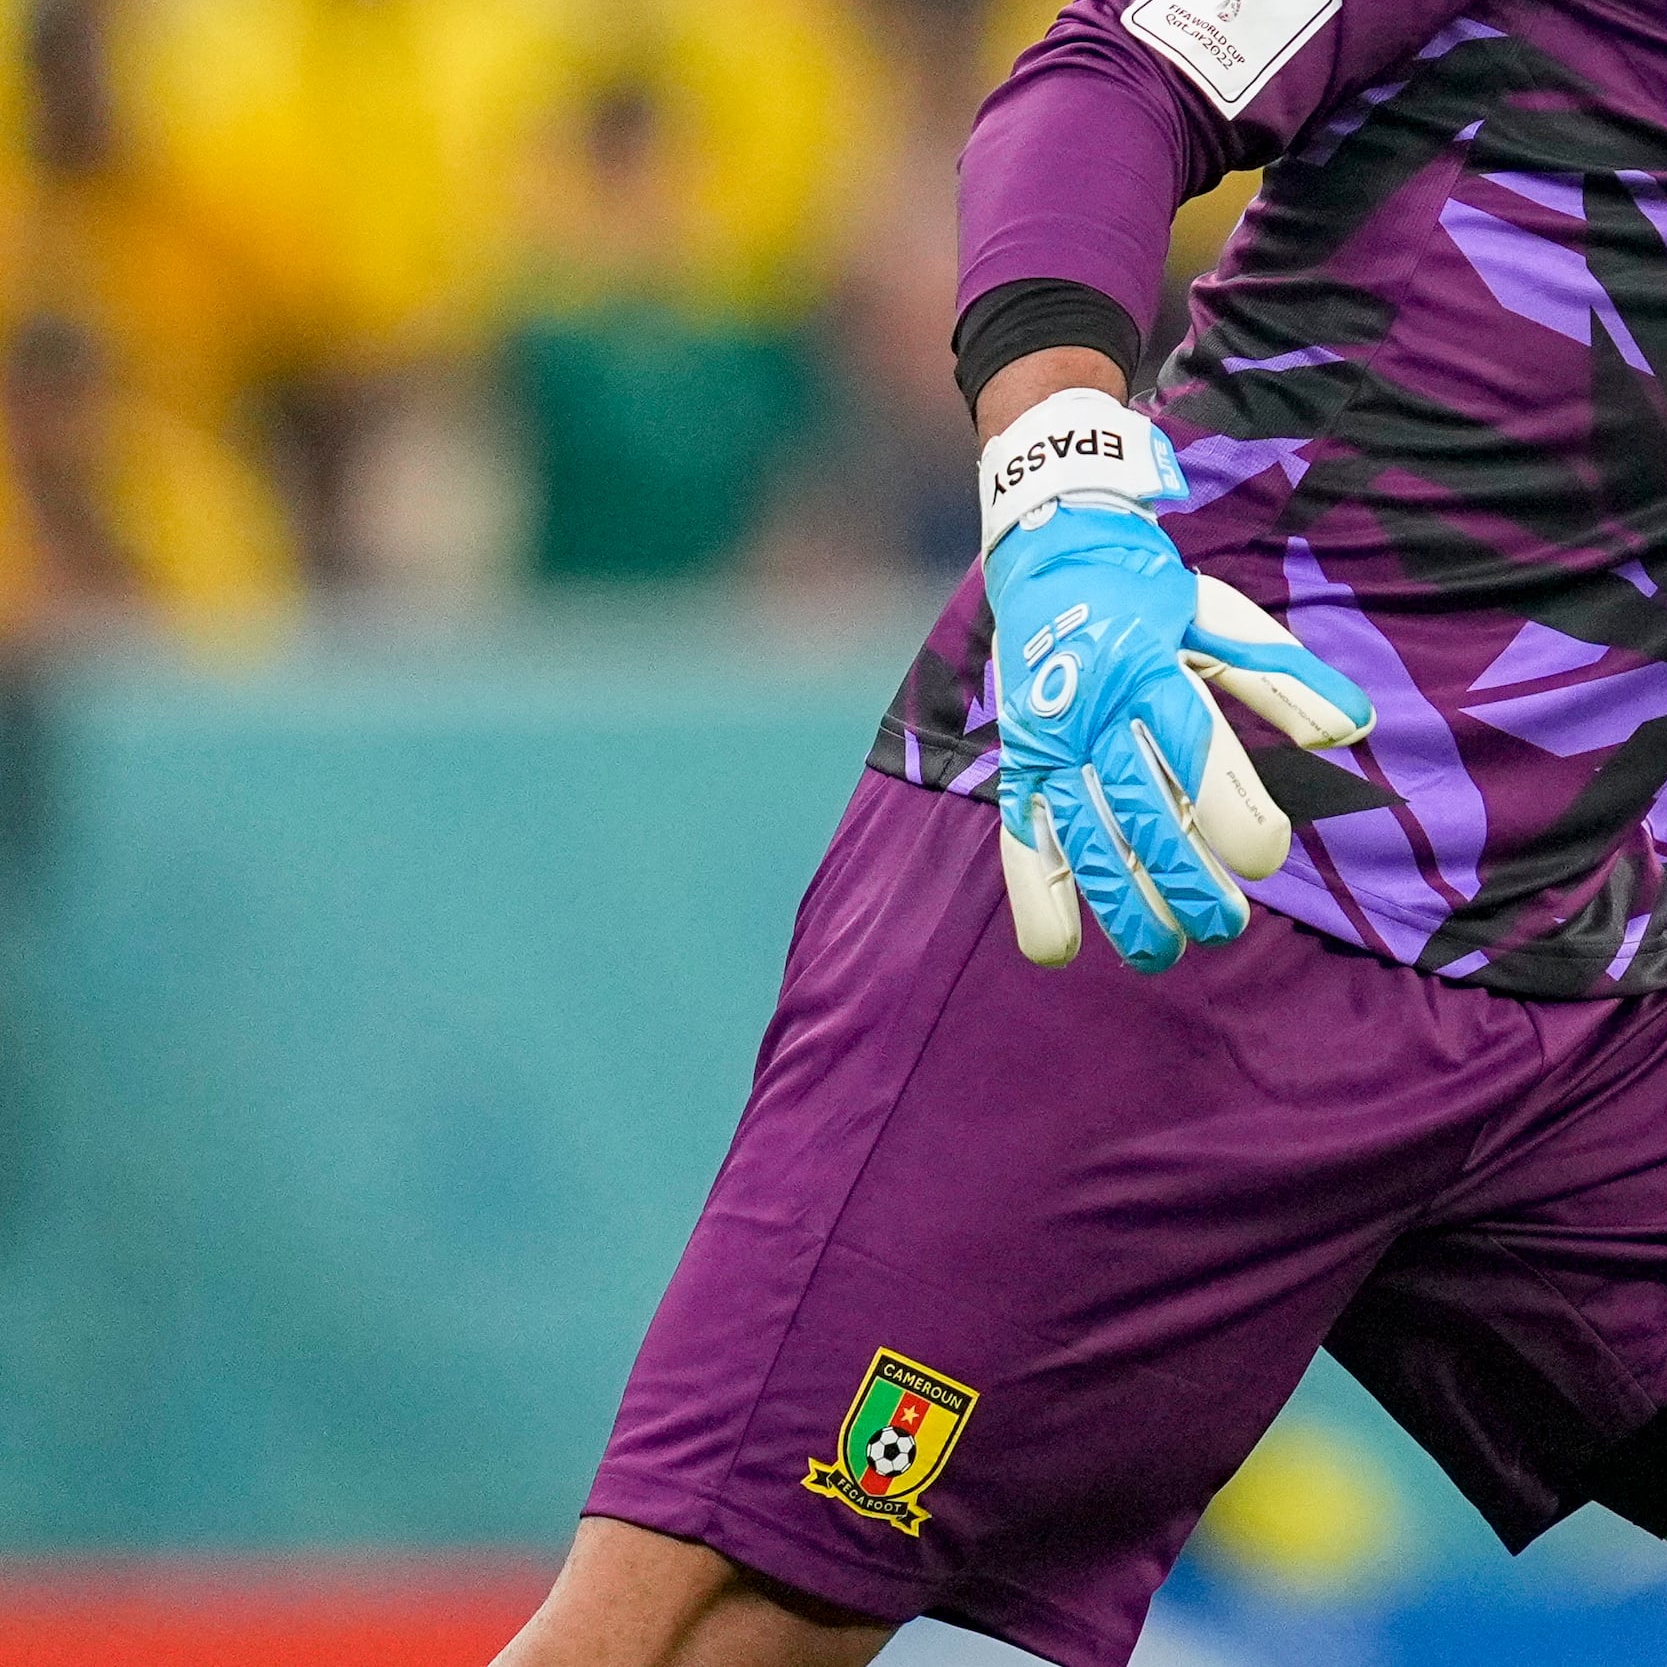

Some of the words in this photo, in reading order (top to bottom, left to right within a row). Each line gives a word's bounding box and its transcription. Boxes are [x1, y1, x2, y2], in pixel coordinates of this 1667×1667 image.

[1169, 4, 1191, 21] FIFA
[1192, 17, 1227, 46] WORLD
[1226, 44, 1246, 64] CUP
[991, 429, 1124, 508] EPASSY
[1226, 770, 1247, 798] PRO
[1245, 798, 1267, 826] LINE
[883, 1363, 964, 1410] CAMEROUN
